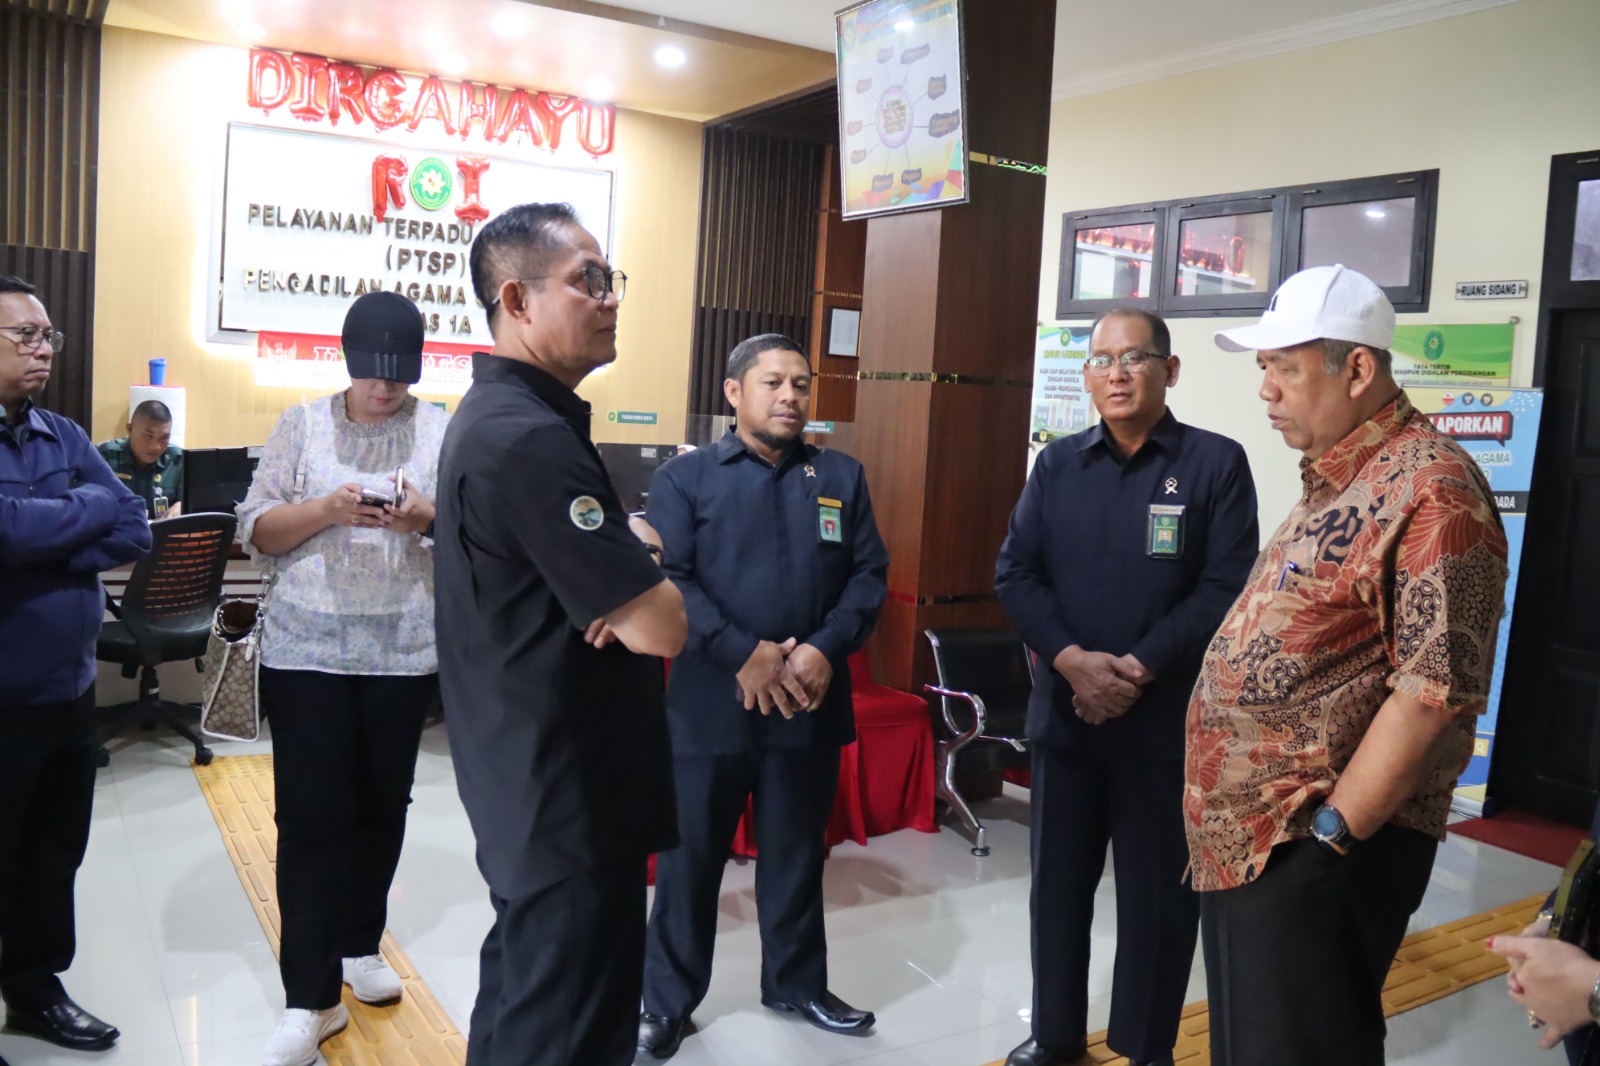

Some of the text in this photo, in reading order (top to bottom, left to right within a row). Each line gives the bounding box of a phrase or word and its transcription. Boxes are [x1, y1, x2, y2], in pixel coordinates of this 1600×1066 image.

[248, 47, 616, 157] DIRGAHAYU
[248, 203, 473, 245] PELAYANAN TERPADU
[386, 245, 466, 278] (PTSP)
[243, 268, 467, 306] PENGADILAN AGAMA
[1461, 285, 1487, 296] RUANG
[1488, 284, 1516, 296] SIDANG
[449, 314, 472, 335] 1A
